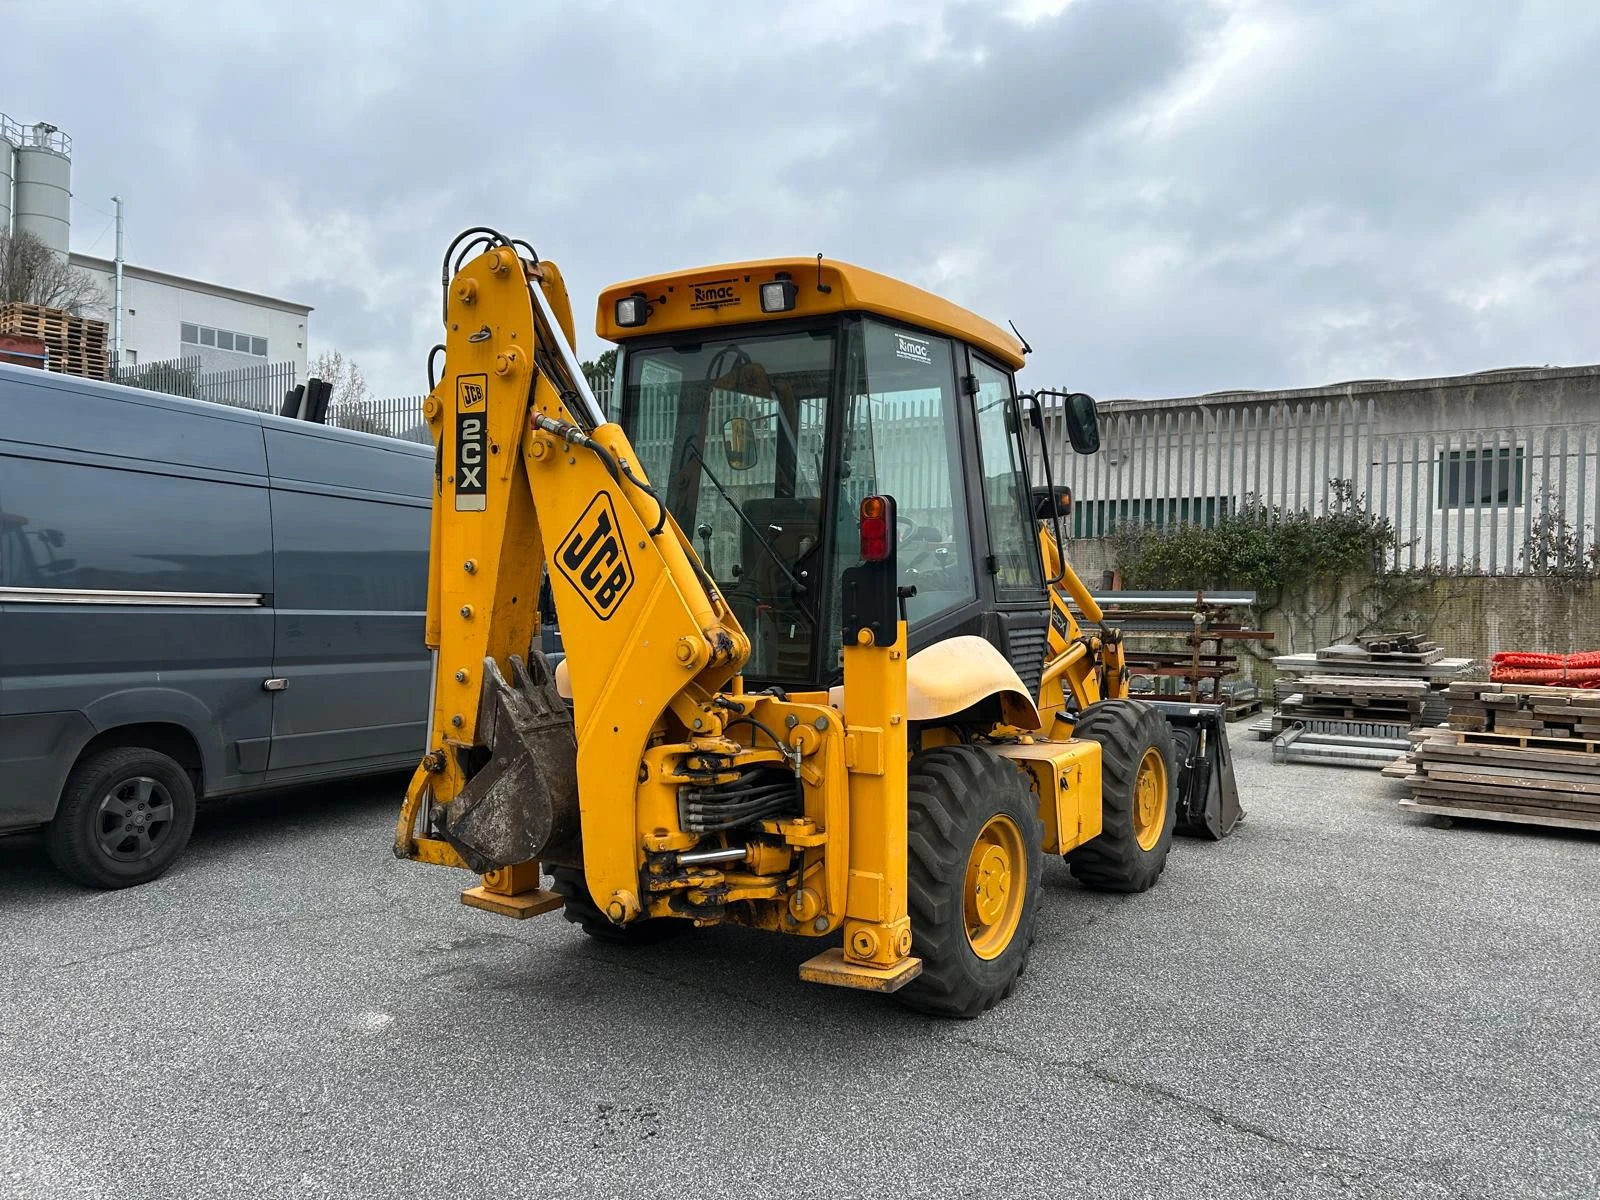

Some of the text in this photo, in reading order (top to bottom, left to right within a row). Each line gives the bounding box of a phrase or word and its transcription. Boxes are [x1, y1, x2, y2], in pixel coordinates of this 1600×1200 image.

[694, 286, 733, 302] Rimac
[464, 383, 482, 405] JCB
[460, 418, 482, 488] 2CX
[563, 508, 627, 610] JCB
